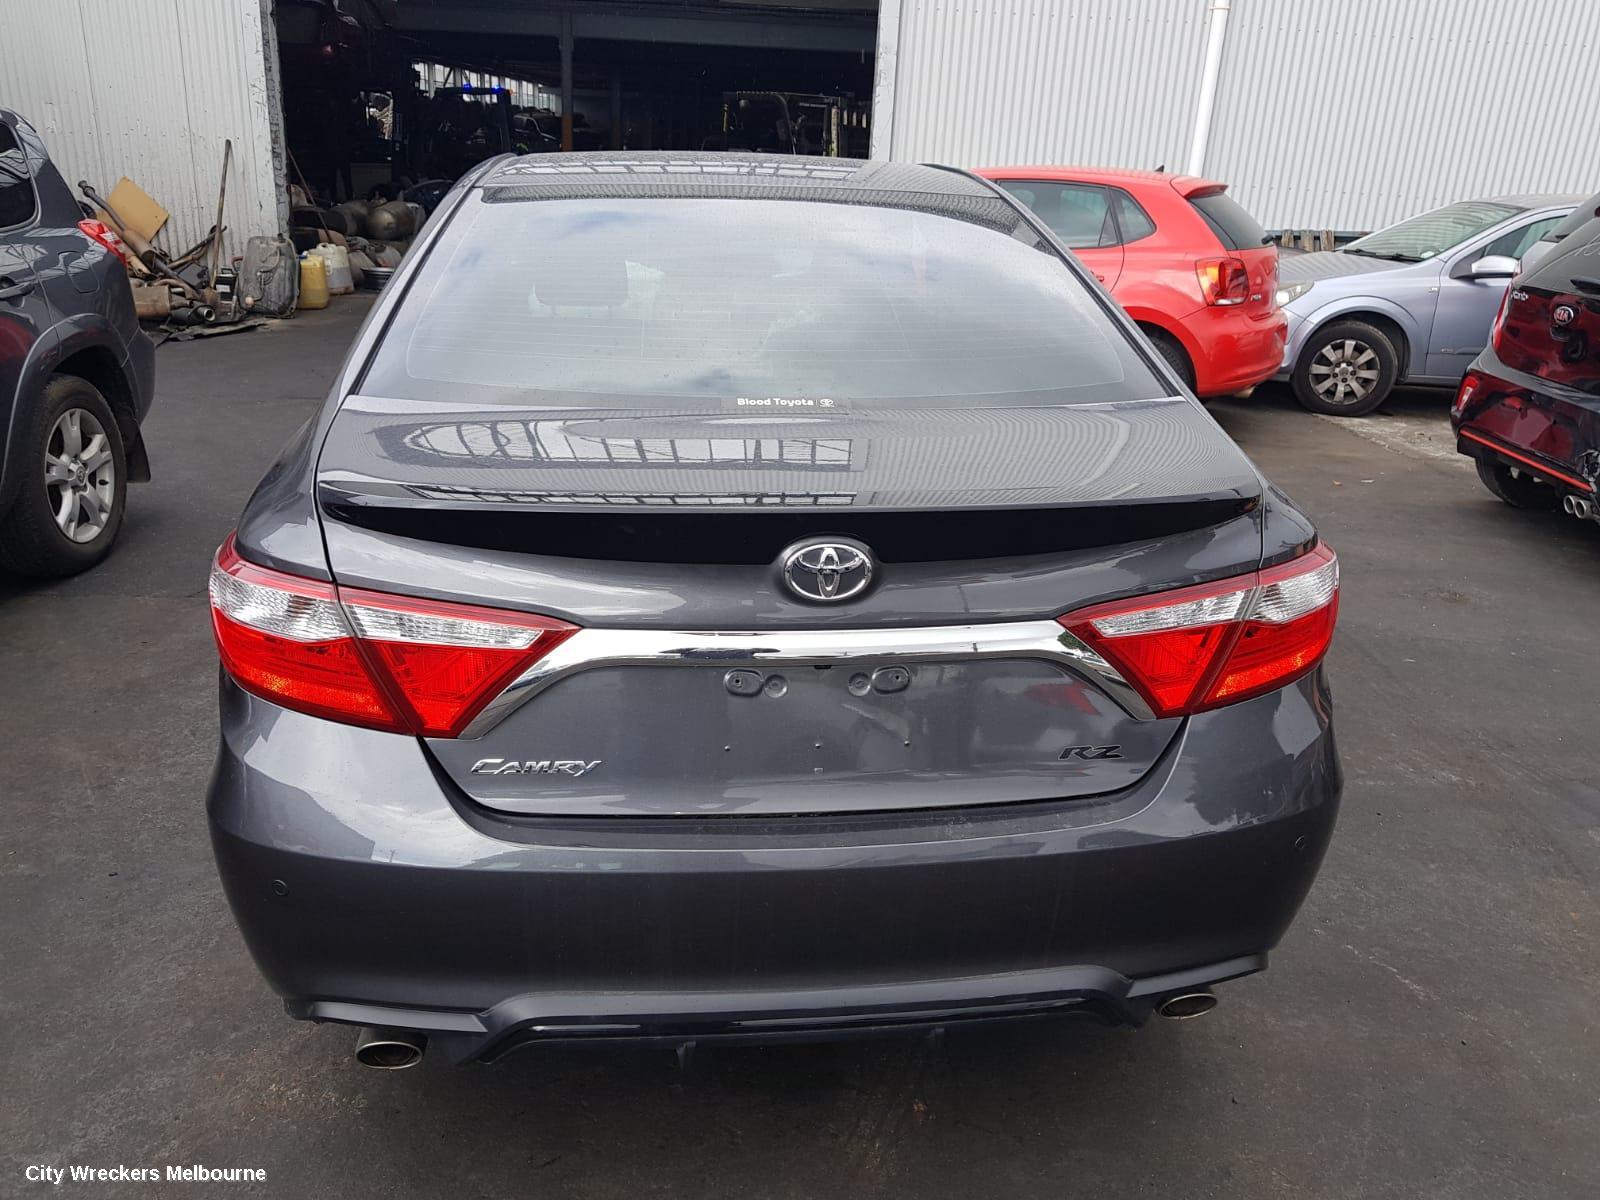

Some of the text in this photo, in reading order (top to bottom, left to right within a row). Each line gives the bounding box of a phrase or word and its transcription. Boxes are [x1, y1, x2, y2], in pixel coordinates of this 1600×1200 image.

[737, 398, 771, 406] Blood
[773, 398, 814, 406] Toyota
[1058, 745, 1124, 761] RZ
